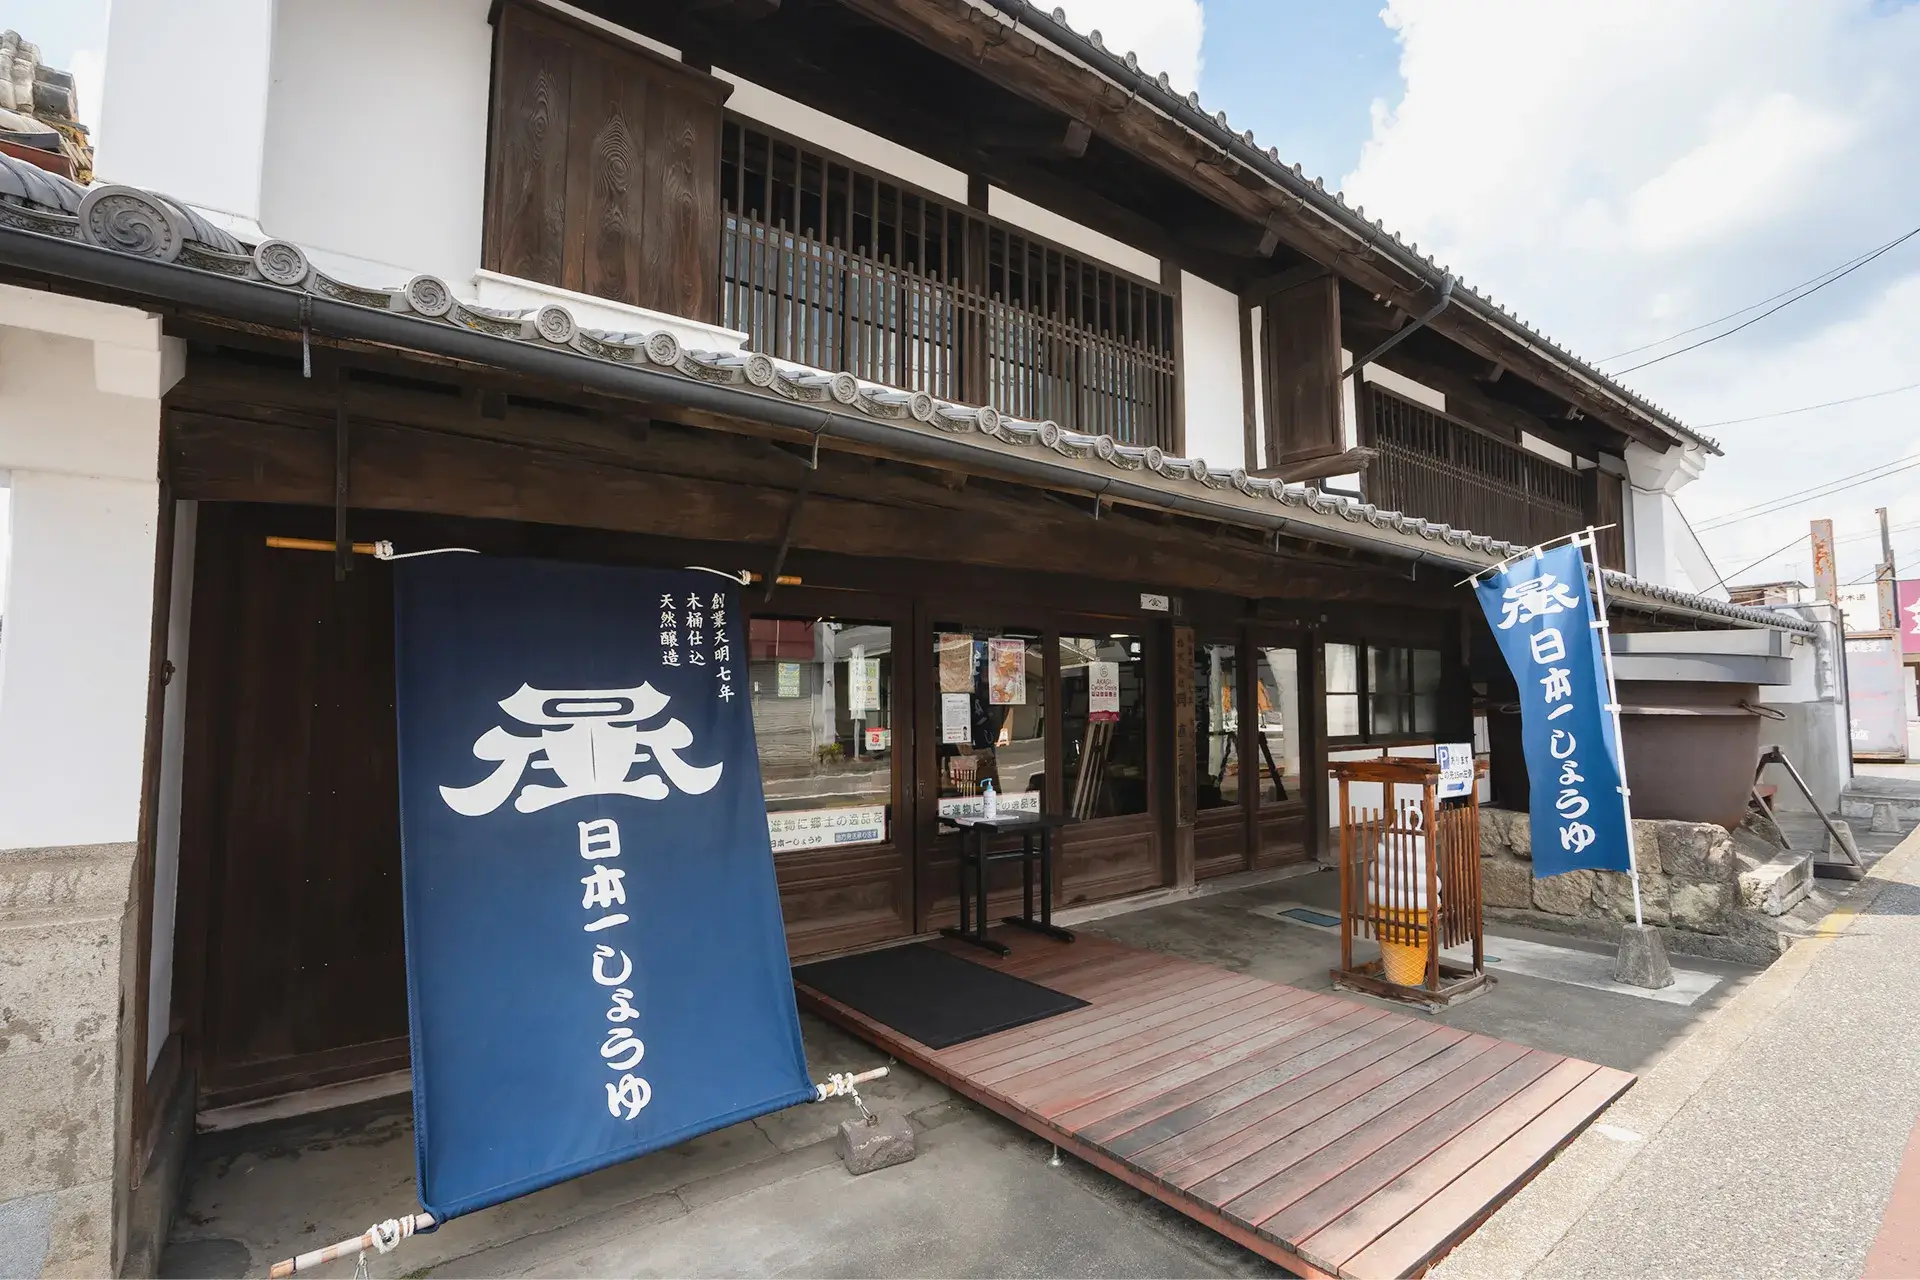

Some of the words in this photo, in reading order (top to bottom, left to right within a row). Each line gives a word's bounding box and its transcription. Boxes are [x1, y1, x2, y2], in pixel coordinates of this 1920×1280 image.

[686, 592, 706, 667] 木桶仕込
[710, 592, 735, 703] 創業天明七年
[1530, 627, 1596, 854] 日本一しょうゆ
[943, 798, 1037, 816] ご進物にの逸品を
[578, 818, 651, 1121] 日本一しょうゆ
